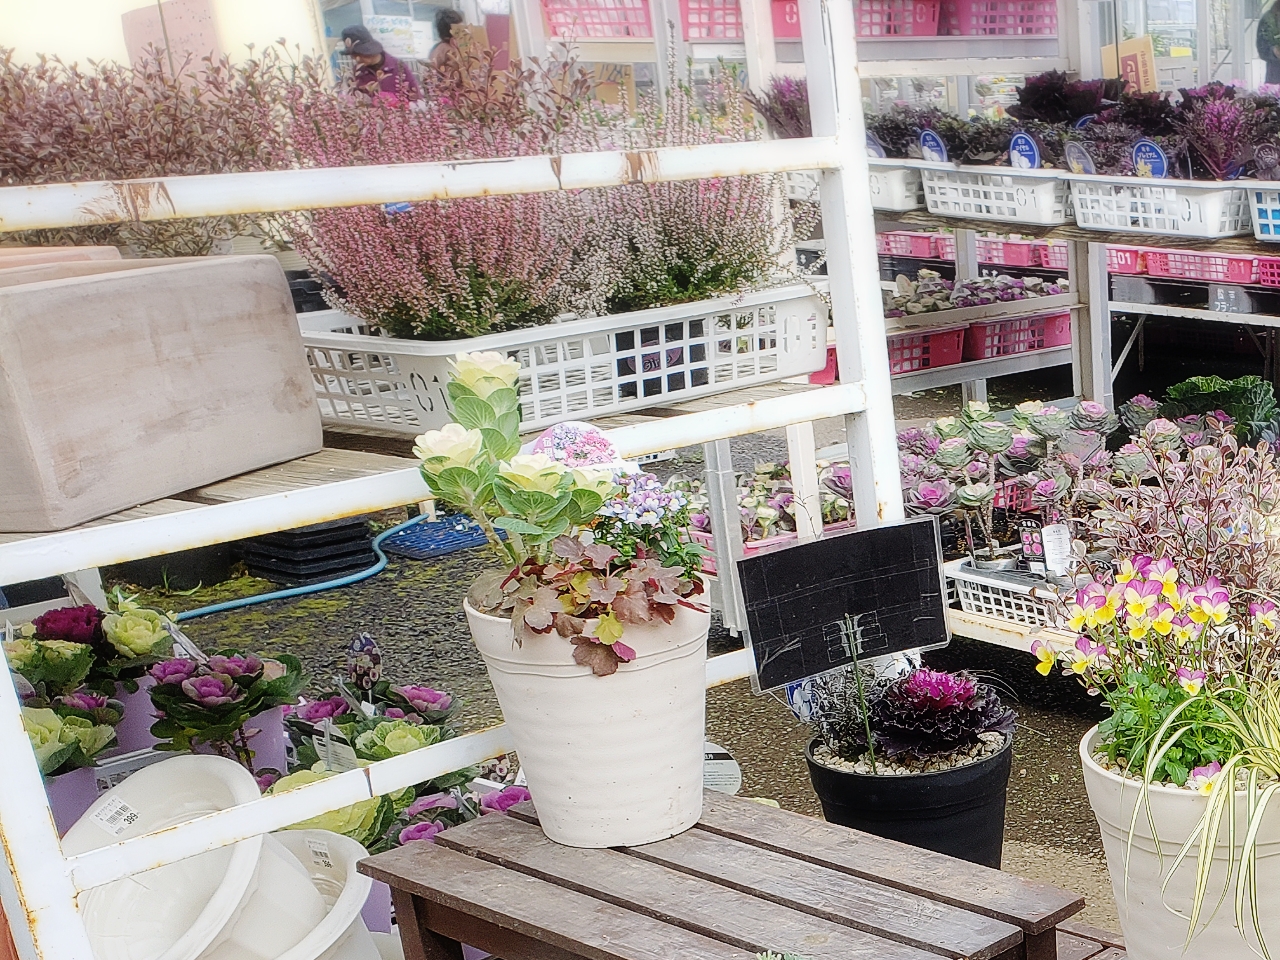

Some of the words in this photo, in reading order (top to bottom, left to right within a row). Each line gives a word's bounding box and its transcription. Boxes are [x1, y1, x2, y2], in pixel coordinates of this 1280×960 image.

[1016, 187, 1036, 208] 01
[1180, 197, 1203, 224] 01
[1117, 251, 1132, 265] 01
[123, 812, 139, 825] 399
